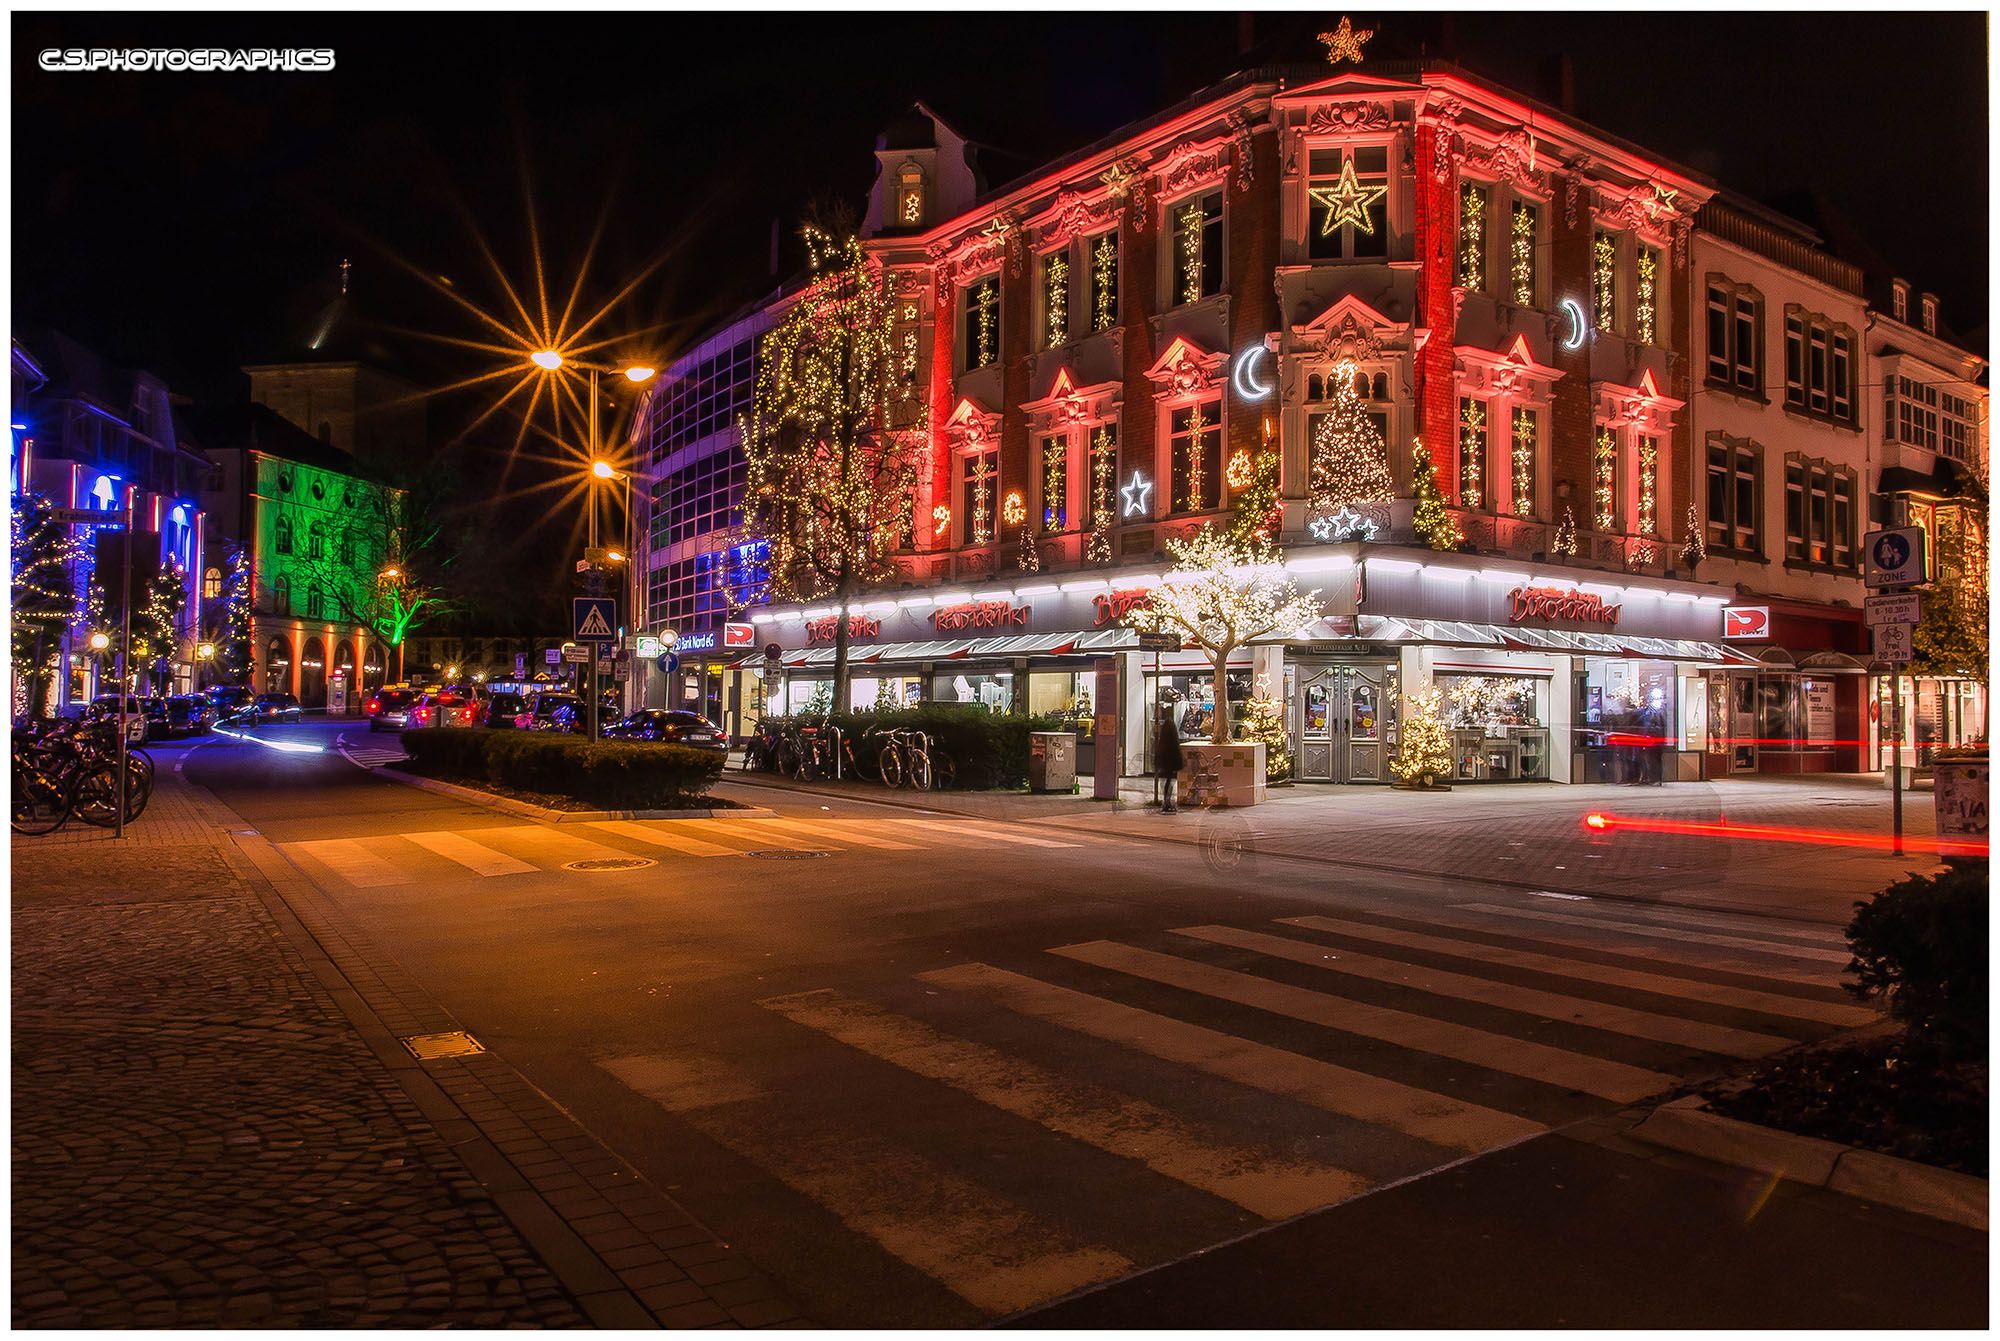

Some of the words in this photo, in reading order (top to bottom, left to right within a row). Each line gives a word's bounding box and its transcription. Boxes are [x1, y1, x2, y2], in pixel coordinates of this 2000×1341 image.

[1879, 571, 1906, 583] ZONE
[692, 633, 706, 649] Nord
[706, 632, 714, 648] eG
